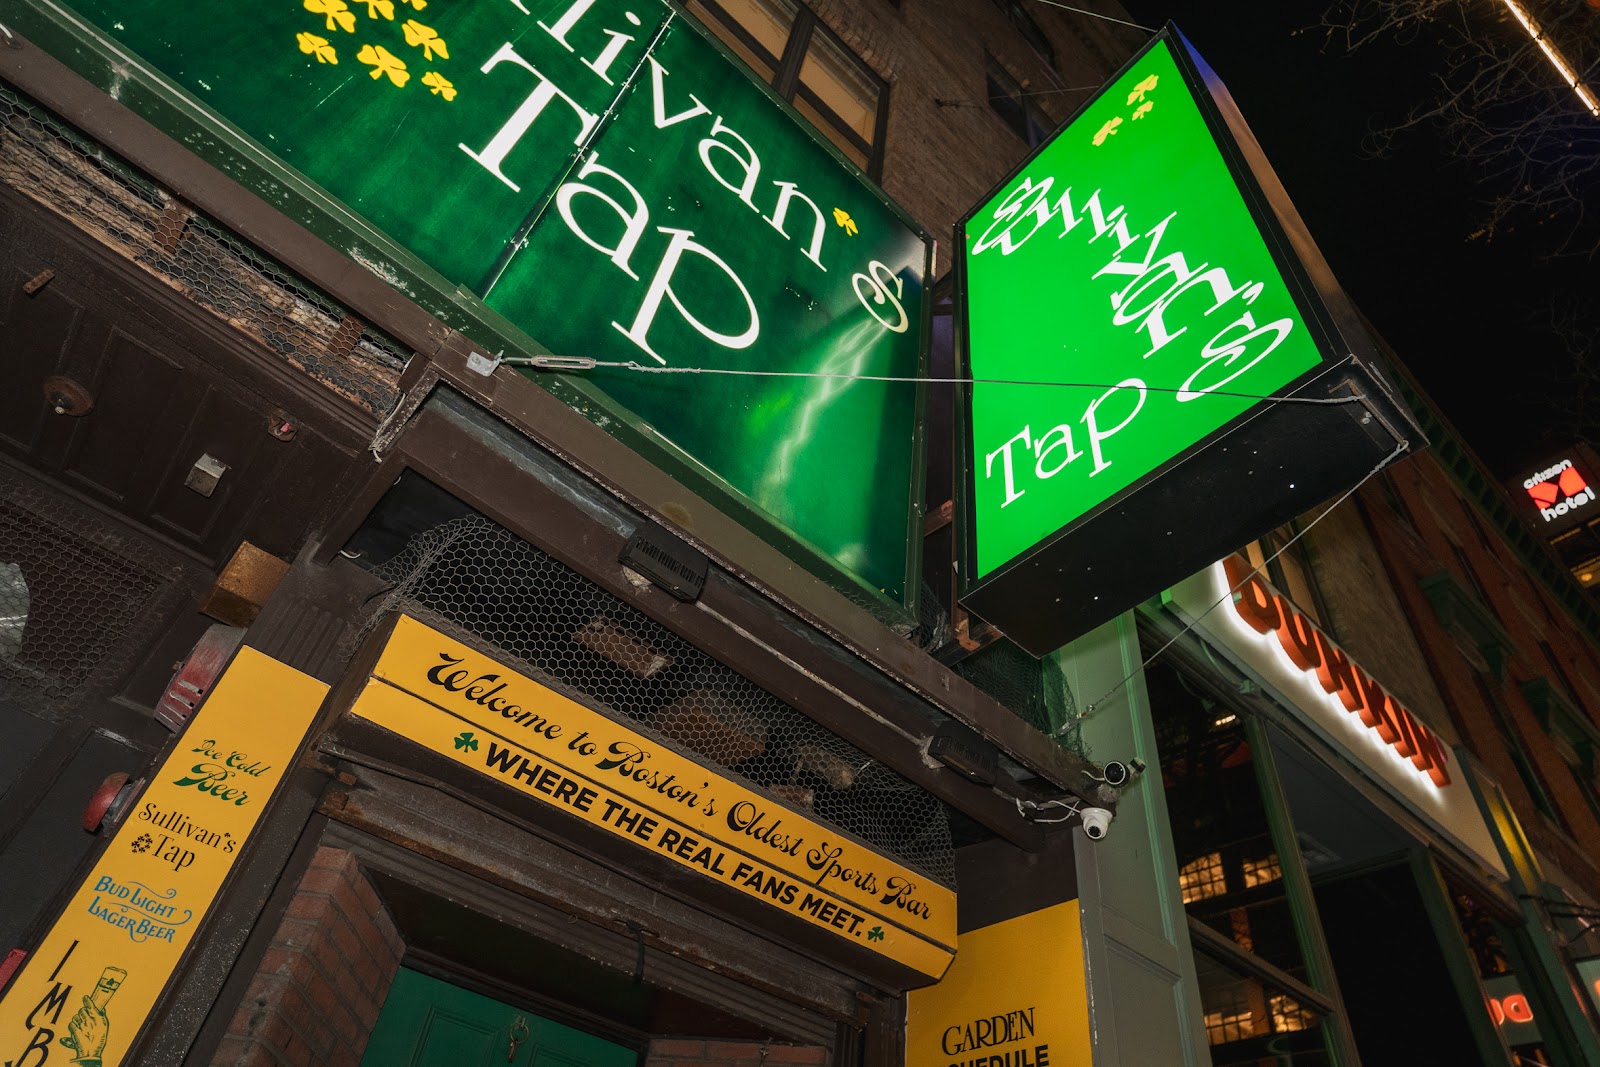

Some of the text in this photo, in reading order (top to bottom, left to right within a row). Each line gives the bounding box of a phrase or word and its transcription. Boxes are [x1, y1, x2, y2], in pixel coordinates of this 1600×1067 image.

[459, 42, 760, 365] Tap
[985, 378, 1147, 508] Tap
[172, 762, 251, 806] Beer
[191, 739, 272, 778] Ice Cold
[427, 652, 932, 920] Welcome to Boston's Oldest Sports Bar
[151, 833, 196, 873] Tap
[485, 742, 866, 937] WHERE THE REAL FANS MEET.
[941, 1007, 1036, 1056] GARDEN
